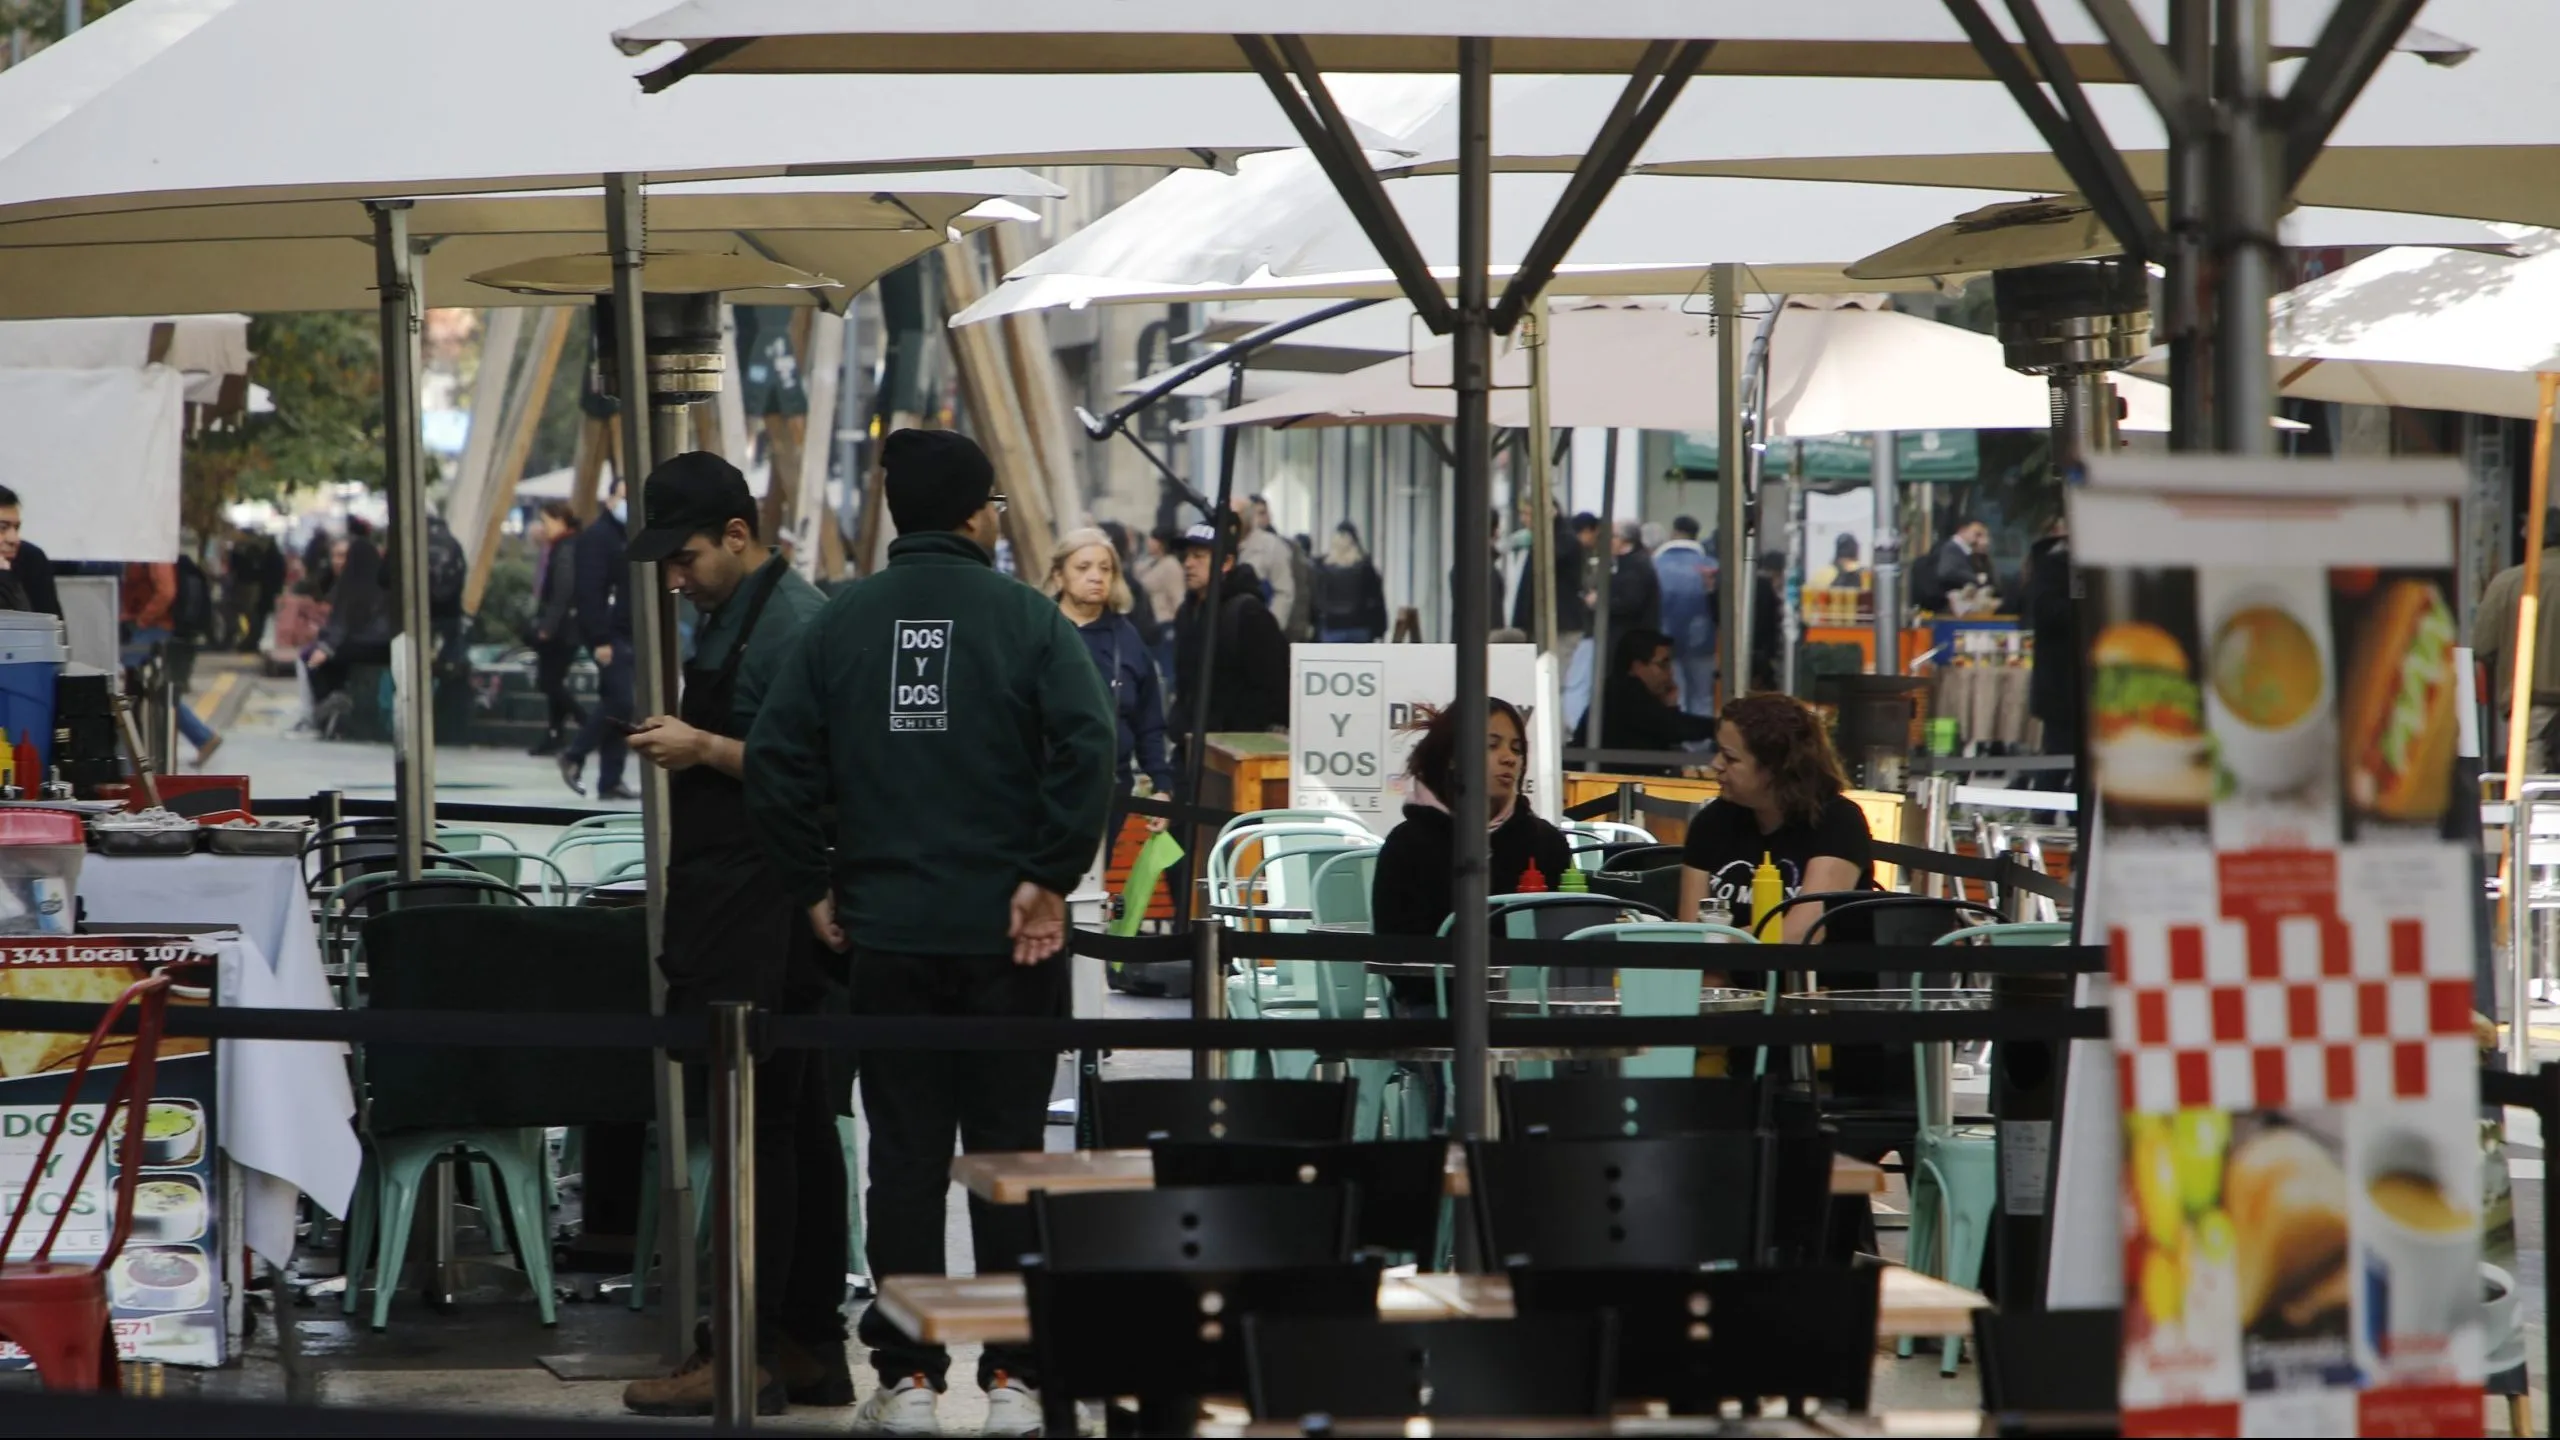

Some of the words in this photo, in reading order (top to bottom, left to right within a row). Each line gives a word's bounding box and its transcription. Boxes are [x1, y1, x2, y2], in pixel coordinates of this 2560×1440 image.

[902, 628, 944, 649] DOS
[914, 656, 928, 677] Y
[898, 684, 940, 705] DOS
[1305, 671, 1376, 697] DOS
[894, 718, 944, 728] CHILE
[1330, 713, 1352, 737] Y
[1304, 751, 1376, 776] DOS
[11, 947, 60, 963] 341
[3, 1112, 95, 1138] DOS
[36, 1153, 63, 1178] Y
[5, 1191, 96, 1216] DOS
